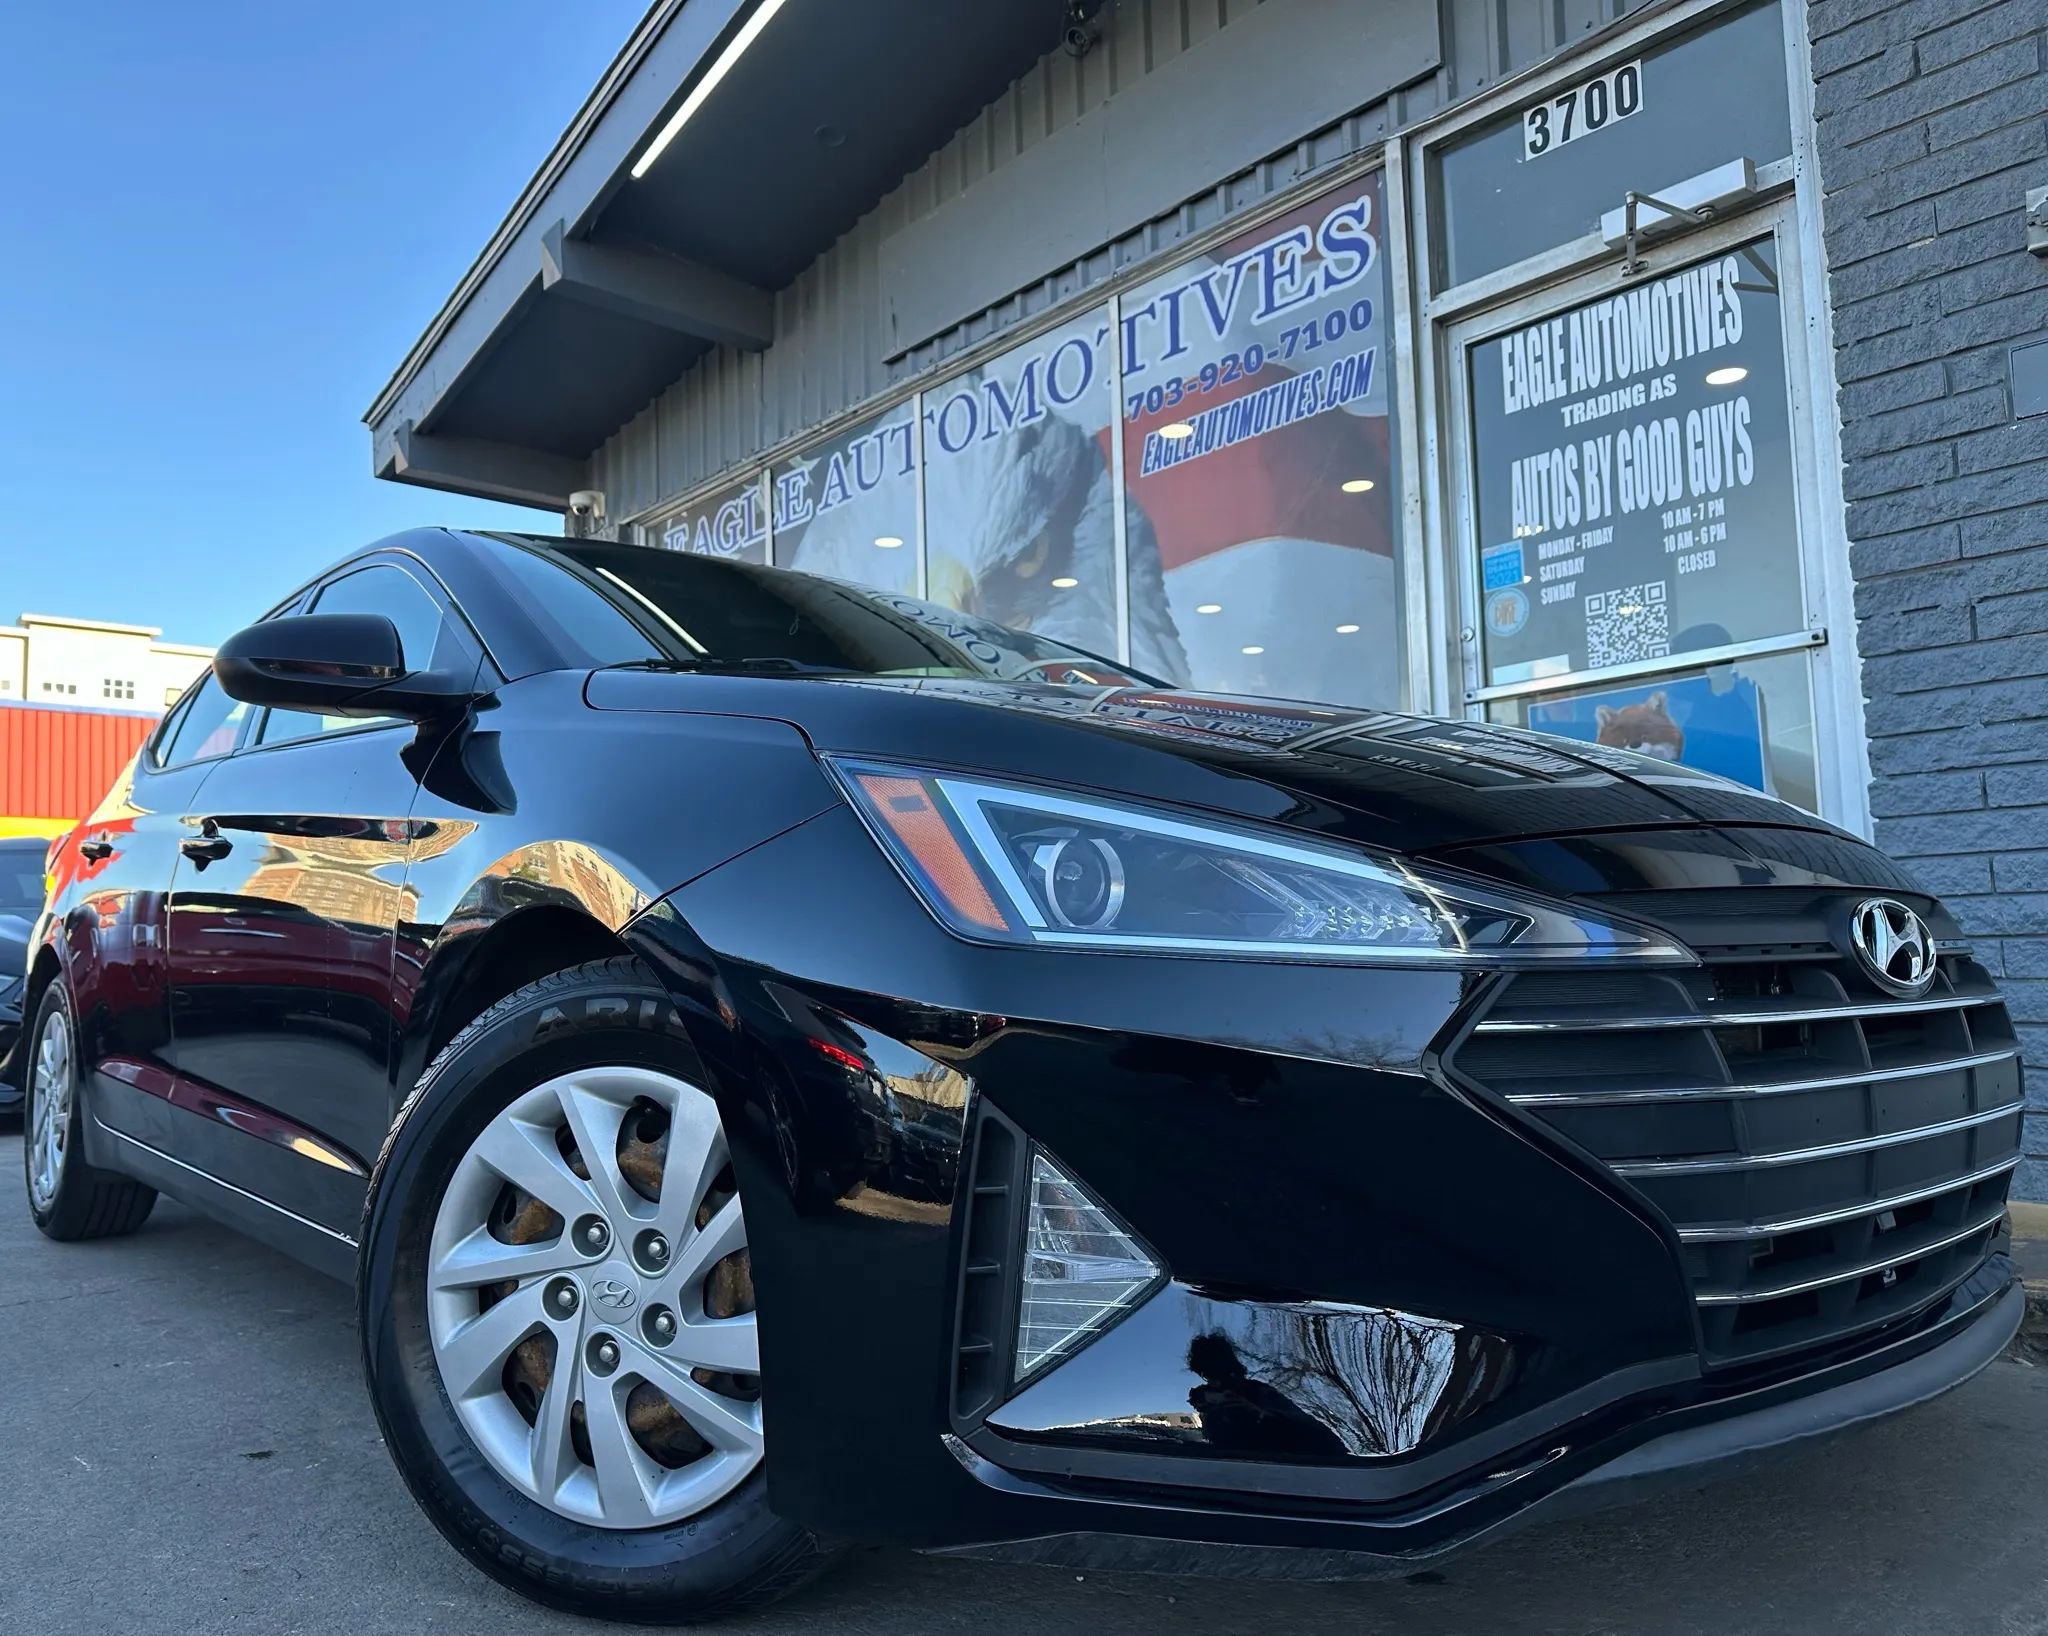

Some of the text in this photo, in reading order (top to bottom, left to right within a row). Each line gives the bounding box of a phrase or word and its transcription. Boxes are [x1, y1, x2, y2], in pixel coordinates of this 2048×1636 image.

[1528, 66, 1638, 155] 3700
[818, 194, 1382, 513] AUTOMOTIVES
[1127, 299, 1373, 423] 703-920-7100
[1501, 256, 1743, 415] EAGLE AUTOMOTIVES
[1140, 346, 1377, 477] EAGLEAUTOMOTIVES.COM
[1561, 373, 1677, 428] TRADING AS
[1512, 396, 1754, 539] AUTOS BY GOOD GUYS
[1661, 510, 1673, 529] 10
[1675, 506, 1692, 525] AM
[1698, 503, 1704, 520] 7
[1708, 498, 1725, 518] PM
[1663, 534, 1675, 553] 10
[1677, 530, 1693, 550] AM
[1700, 528, 1708, 545] 6
[1709, 522, 1726, 543] PM
[1538, 535, 1576, 560] MONDAY
[1581, 526, 1614, 550] FRIDAY
[1540, 556, 1585, 583] SATURDAY
[1678, 550, 1716, 575] CLOSED
[1540, 581, 1577, 605] SUNDAY
